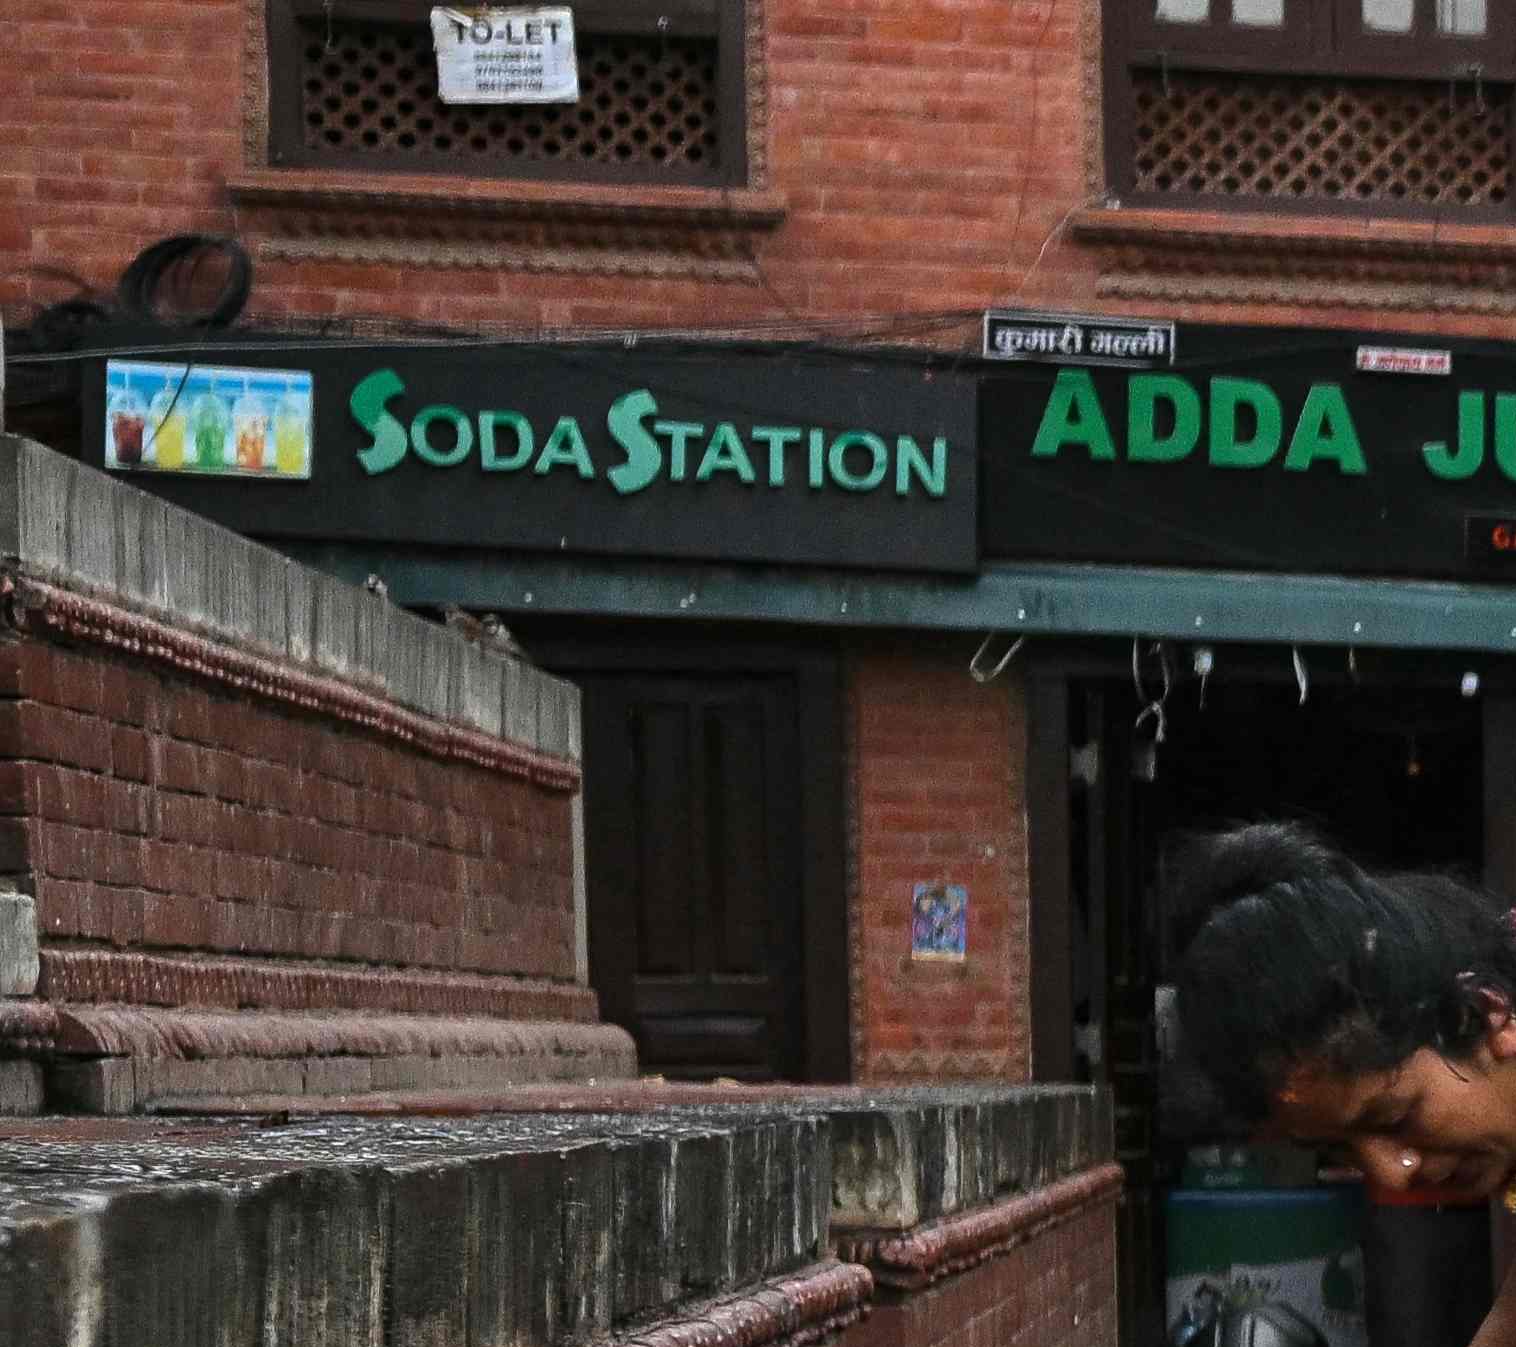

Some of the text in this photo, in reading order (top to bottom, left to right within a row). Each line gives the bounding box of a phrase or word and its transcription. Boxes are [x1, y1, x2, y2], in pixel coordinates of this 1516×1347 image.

[450, 17, 562, 45] TO-LET
[349, 369, 949, 497] SODA STATION
[1031, 368, 1368, 473] ADDA
